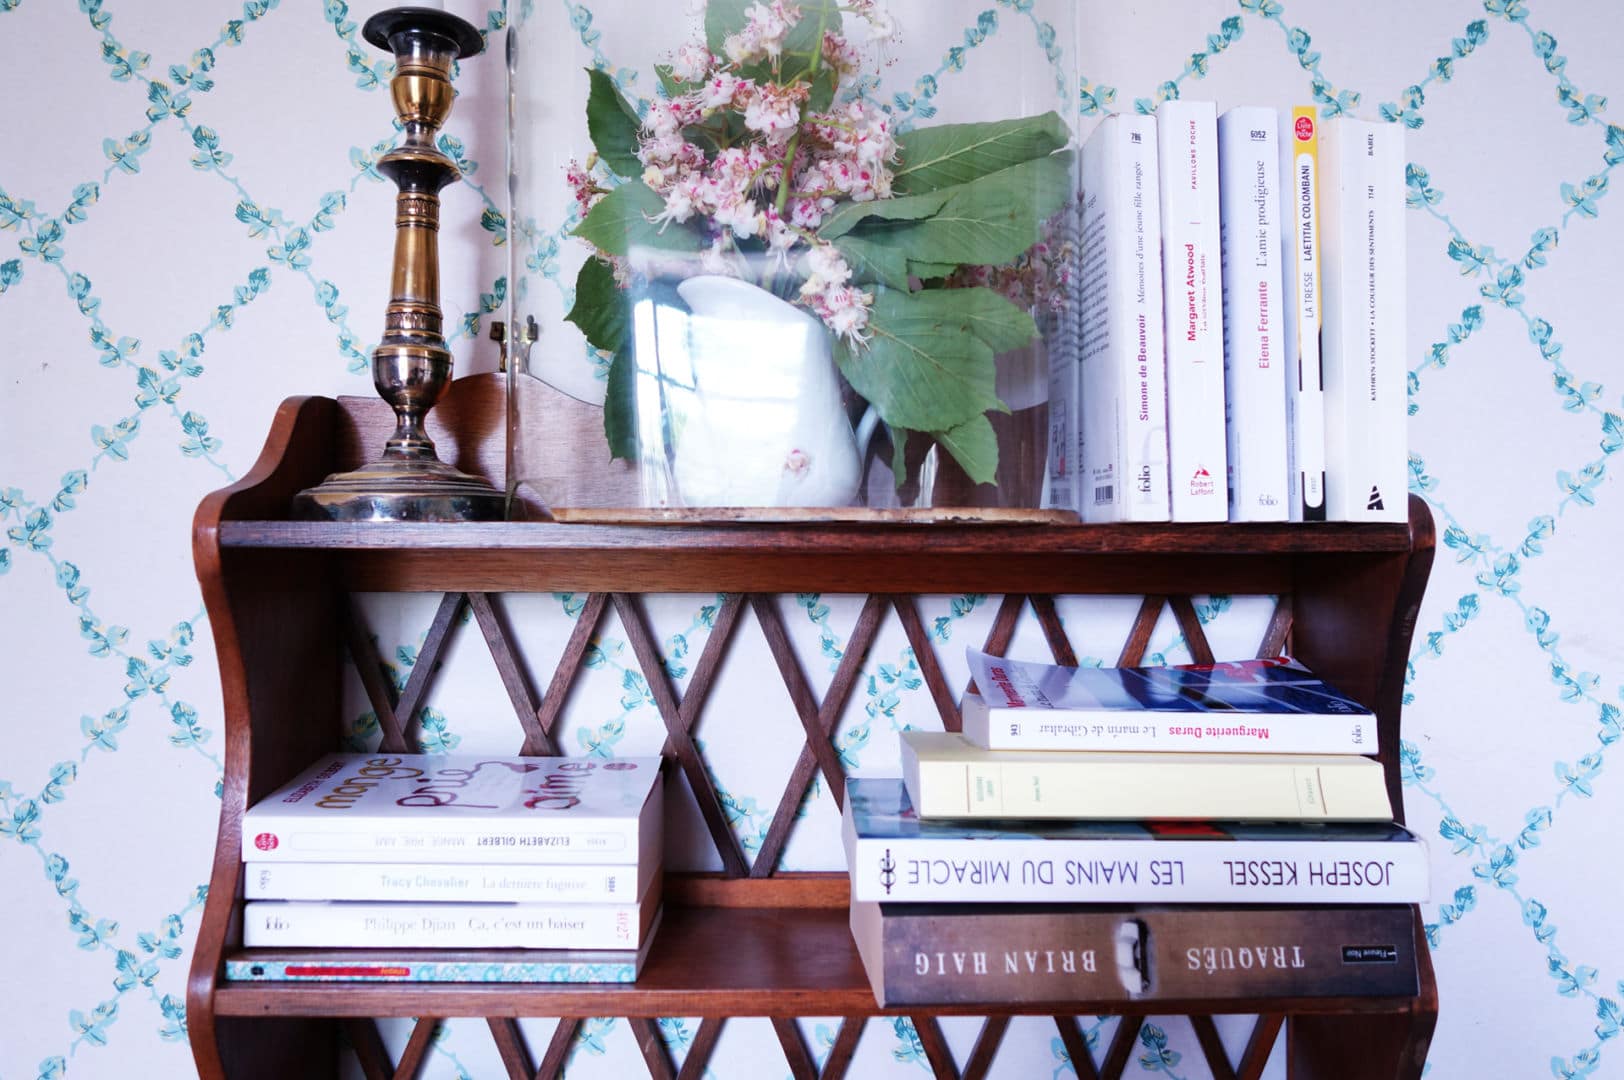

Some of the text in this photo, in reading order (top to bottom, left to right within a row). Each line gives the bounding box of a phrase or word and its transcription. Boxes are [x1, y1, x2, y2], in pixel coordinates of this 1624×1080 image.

[1253, 160, 1269, 226] prodigieuse
[1254, 228, 1267, 267] L'amie
[1301, 165, 1314, 318] LA TRESSE LAETITIA COLOMBANI
[1132, 161, 1149, 421] Simone de Beauvoir Mémoires d'une jeune fille rangée
[1185, 244, 1198, 341] Margaret Atwood
[1257, 281, 1269, 332] Ferrante
[1369, 310, 1375, 320] LA
[1138, 465, 1151, 493] folio
[1190, 479, 1214, 488] Robert
[1258, 493, 1279, 506] folio
[1039, 724, 1088, 738] Gibraltar
[1089, 724, 1105, 738] de
[1141, 725, 1157, 738] Le
[1169, 726, 1203, 739] Duras
[1205, 725, 1270, 740] Marguerite
[476, 836, 516, 847] GILBERT
[519, 836, 570, 847] ELIZABETH
[907, 858, 1185, 886] LES MAINS DU MIRACLE
[1222, 860, 1396, 886] JOSEPH KESSEL
[380, 875, 412, 889] Tracy
[468, 916, 489, 932] Ça,
[494, 917, 522, 930] c'est
[526, 920, 545, 930] un
[548, 916, 587, 930] baiser
[913, 949, 1097, 976] BRIAN HAIG
[1185, 945, 1305, 975] TRAQUÉS
